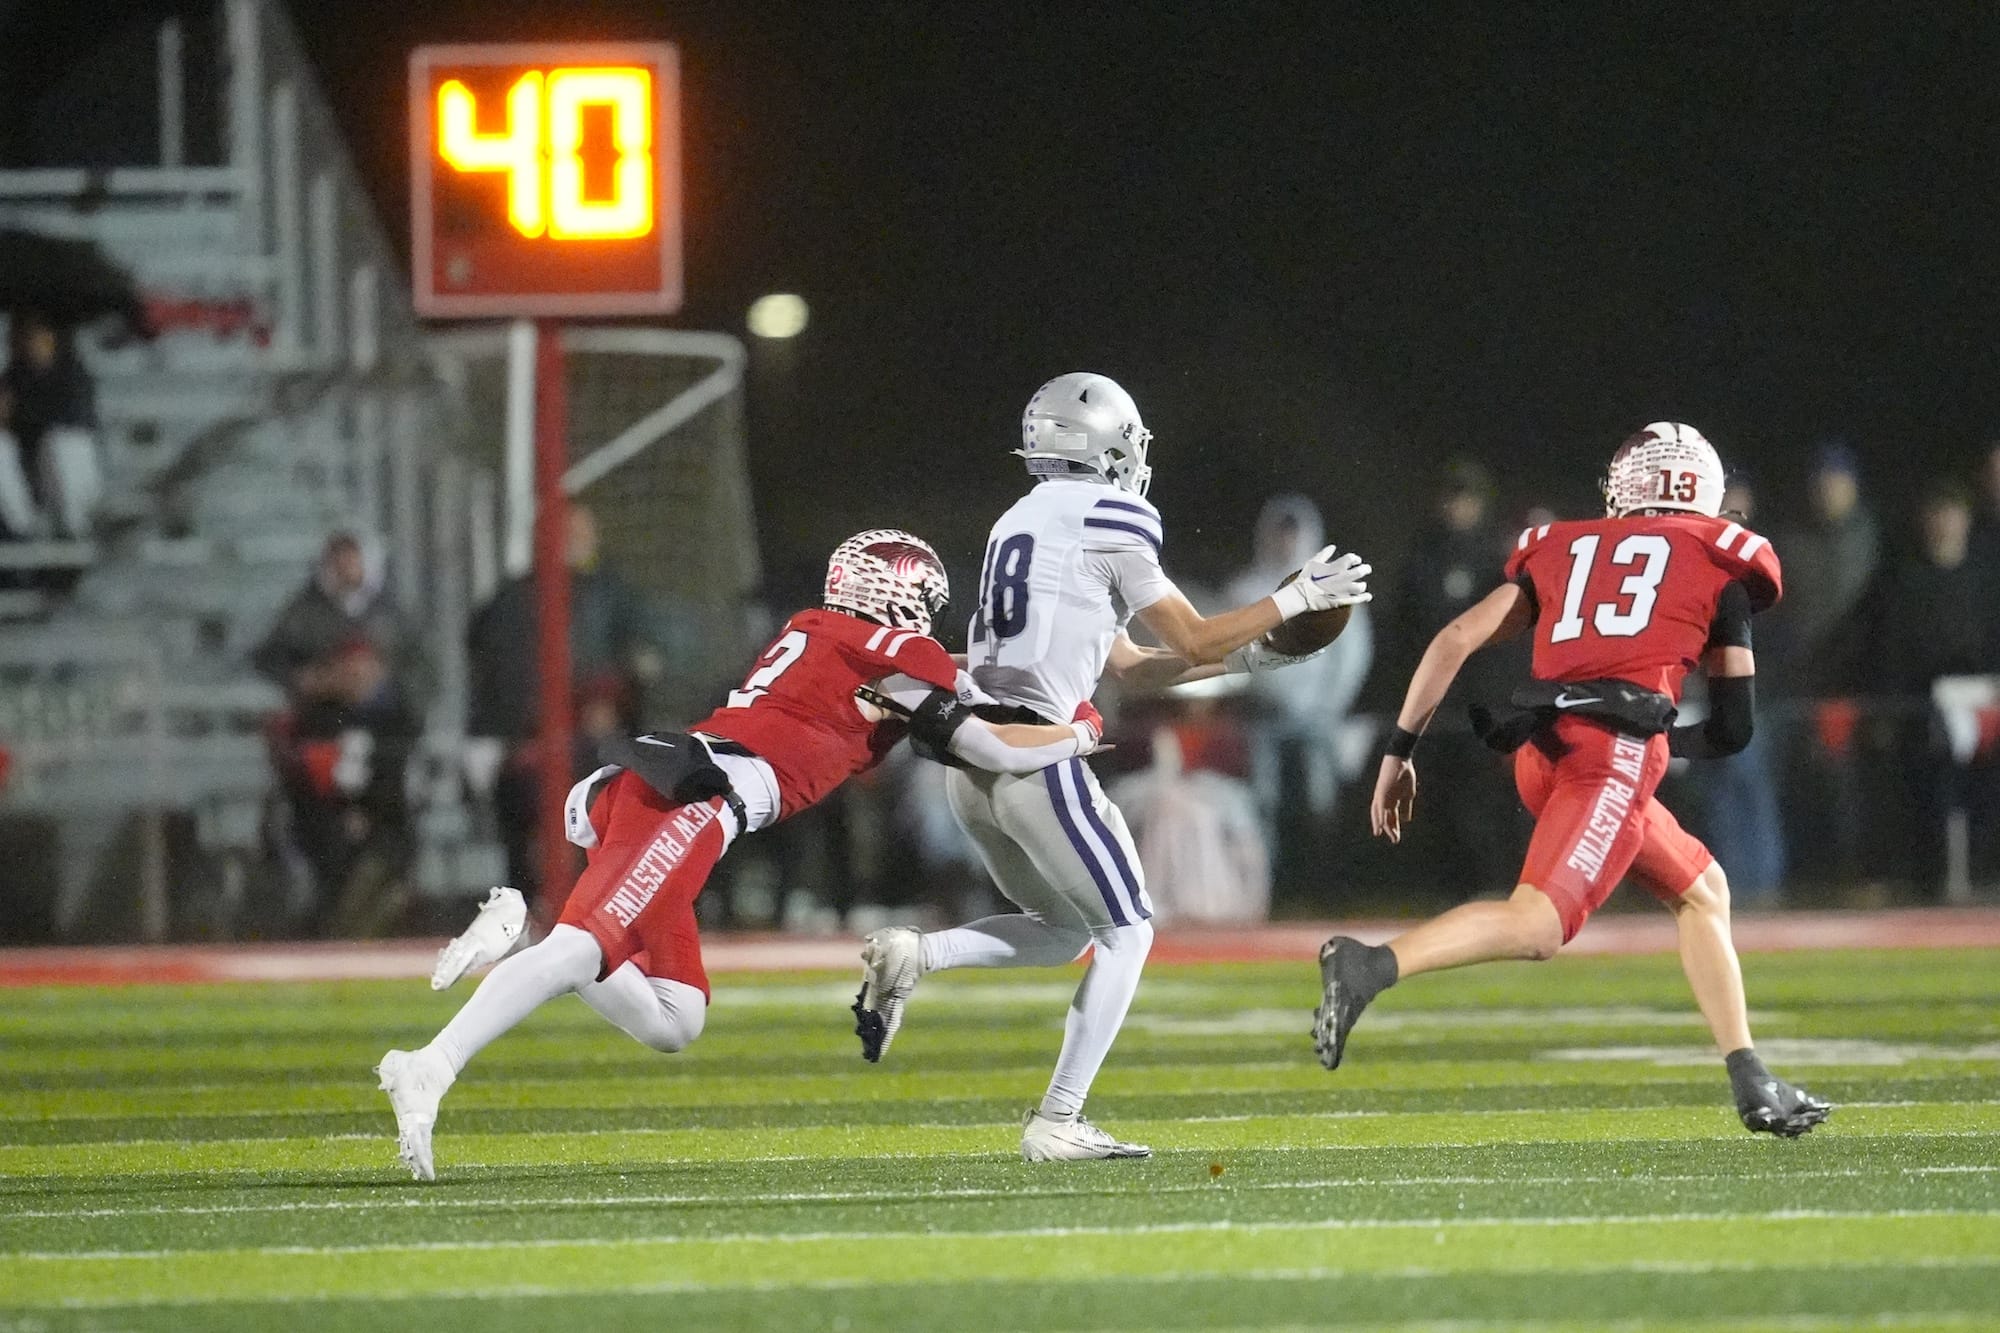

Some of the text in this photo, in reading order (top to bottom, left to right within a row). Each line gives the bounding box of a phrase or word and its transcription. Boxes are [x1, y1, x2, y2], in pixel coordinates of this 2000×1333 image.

[438, 67, 653, 240] 40
[1659, 469, 1698, 503] 13
[828, 565, 843, 595] 2
[973, 533, 1035, 643] 18
[1551, 535, 1672, 644] 13
[726, 630, 808, 709] 2
[603, 801, 717, 929] NEW PALESTINE
[1567, 777, 1635, 883] PALESTINE
